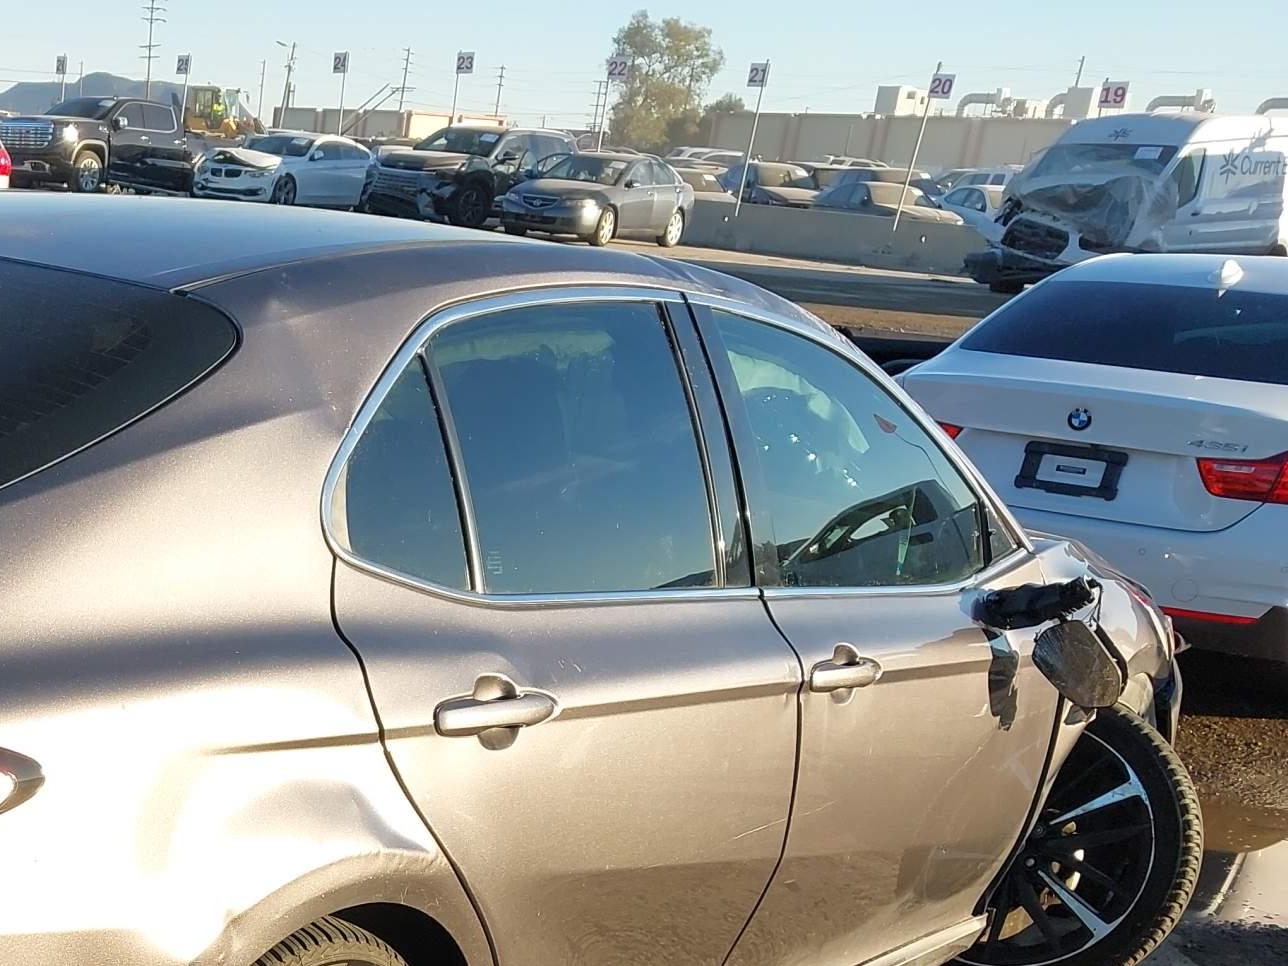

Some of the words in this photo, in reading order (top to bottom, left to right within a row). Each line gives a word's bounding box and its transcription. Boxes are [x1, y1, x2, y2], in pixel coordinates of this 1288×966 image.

[333, 56, 347, 70] 24
[457, 55, 474, 70] 23
[608, 61, 627, 76] 22
[749, 67, 767, 83] 21
[929, 77, 954, 95] 20
[1100, 86, 1127, 104] 19
[1240, 155, 1282, 175] Current
